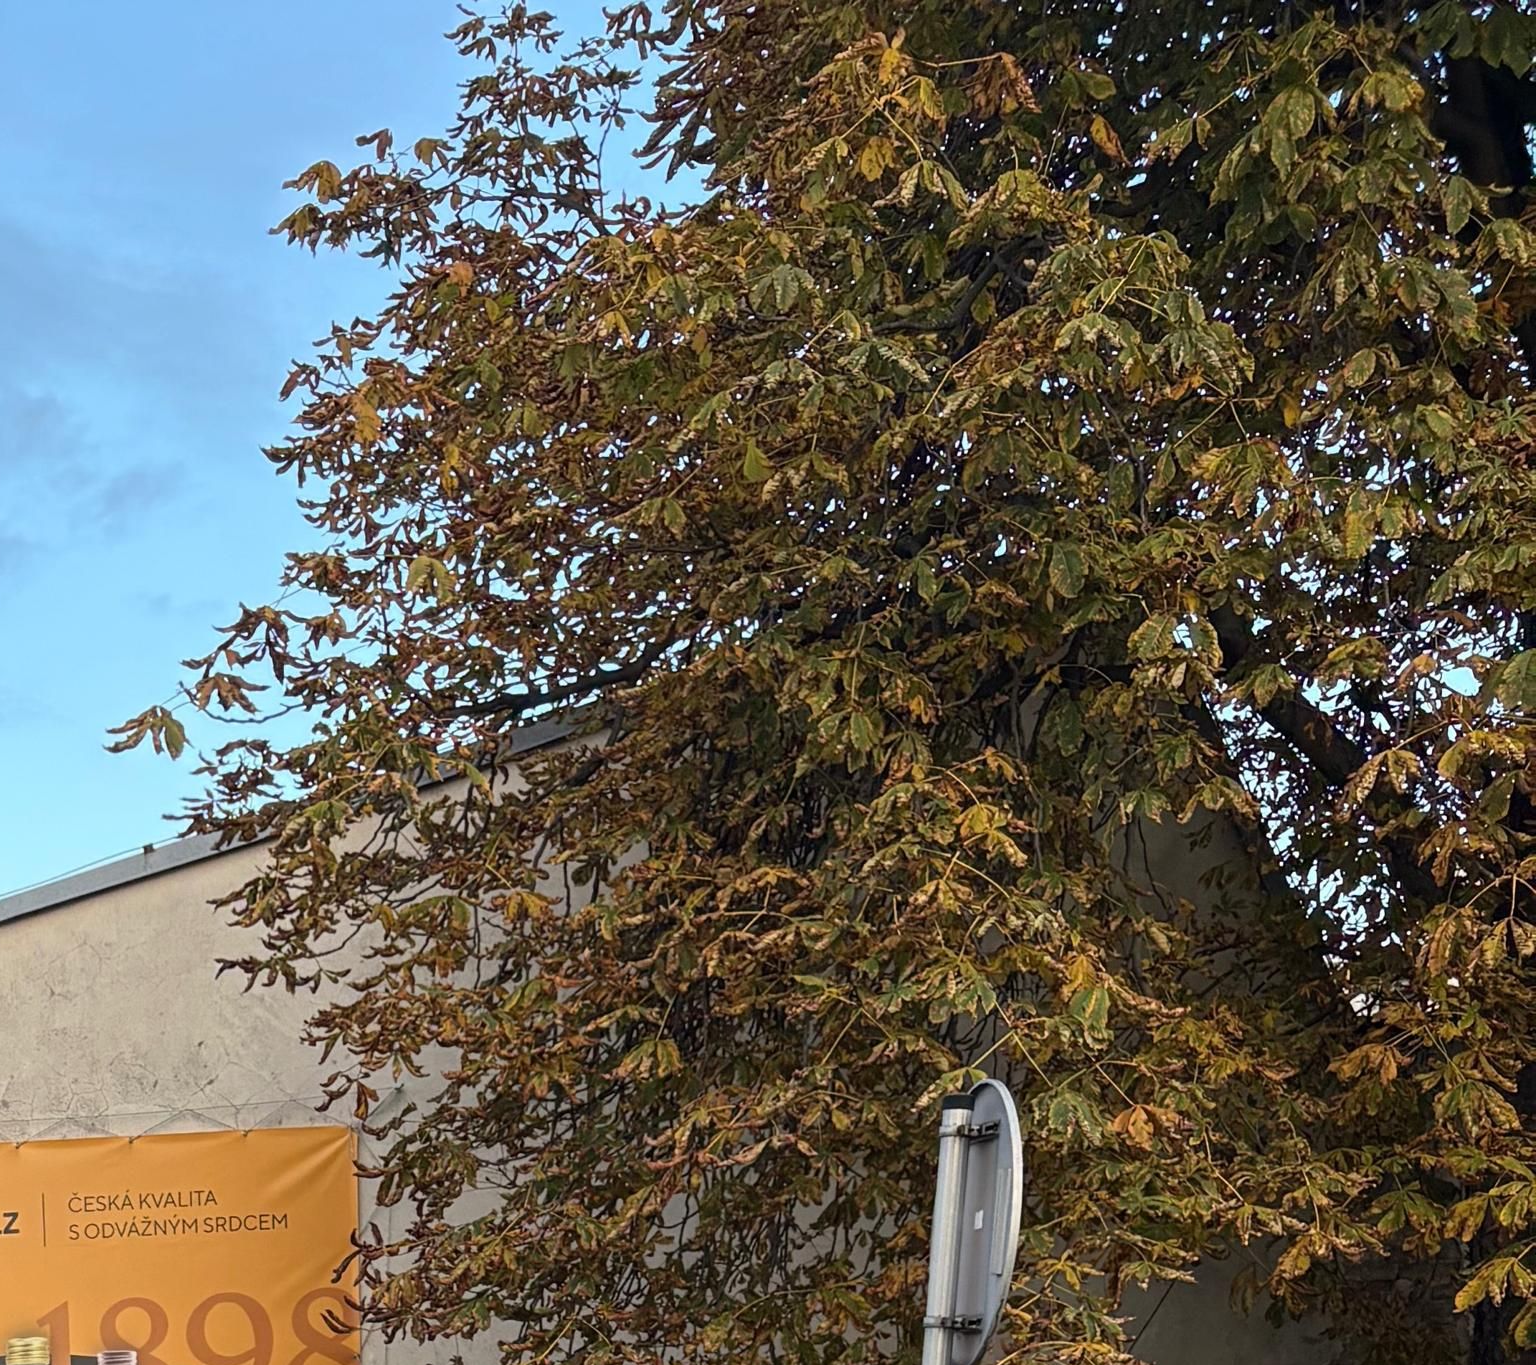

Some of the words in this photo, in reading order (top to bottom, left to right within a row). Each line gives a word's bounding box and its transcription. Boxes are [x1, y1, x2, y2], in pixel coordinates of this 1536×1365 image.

[68, 1188, 135, 1213] ČESKÁ
[139, 1190, 218, 1210] KVALITA
[69, 1224, 80, 1240] S
[84, 1214, 199, 1240] ODVÁŽNÝM
[204, 1213, 288, 1233] SRDCEM
